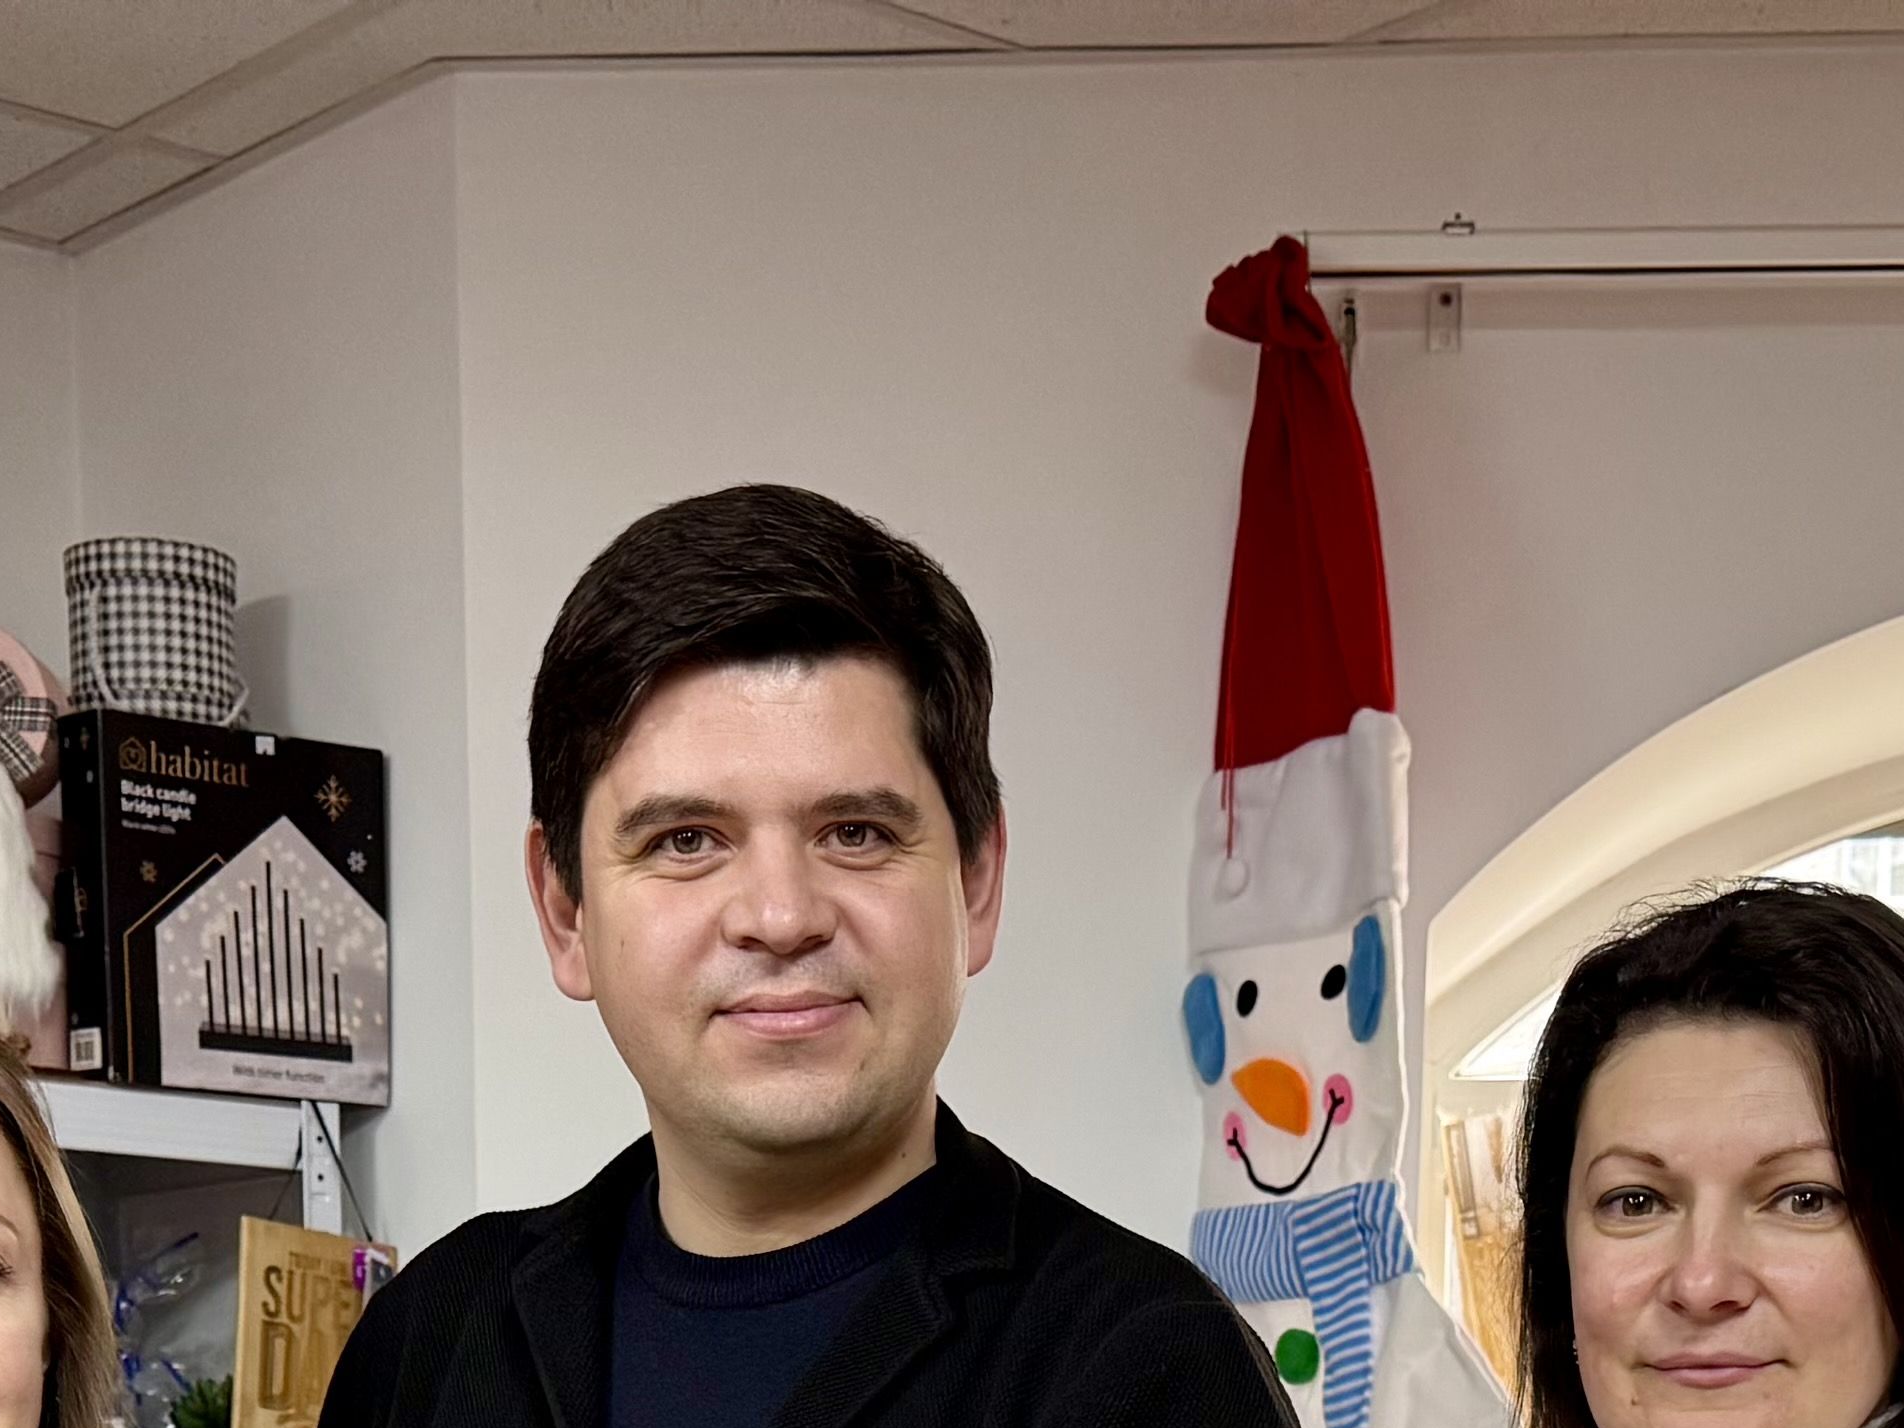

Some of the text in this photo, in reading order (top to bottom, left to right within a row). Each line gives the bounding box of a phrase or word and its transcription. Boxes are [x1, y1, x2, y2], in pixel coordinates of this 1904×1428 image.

[149, 740, 251, 787] habitat
[121, 779, 155, 798] Black
[121, 797, 192, 822] bridge light
